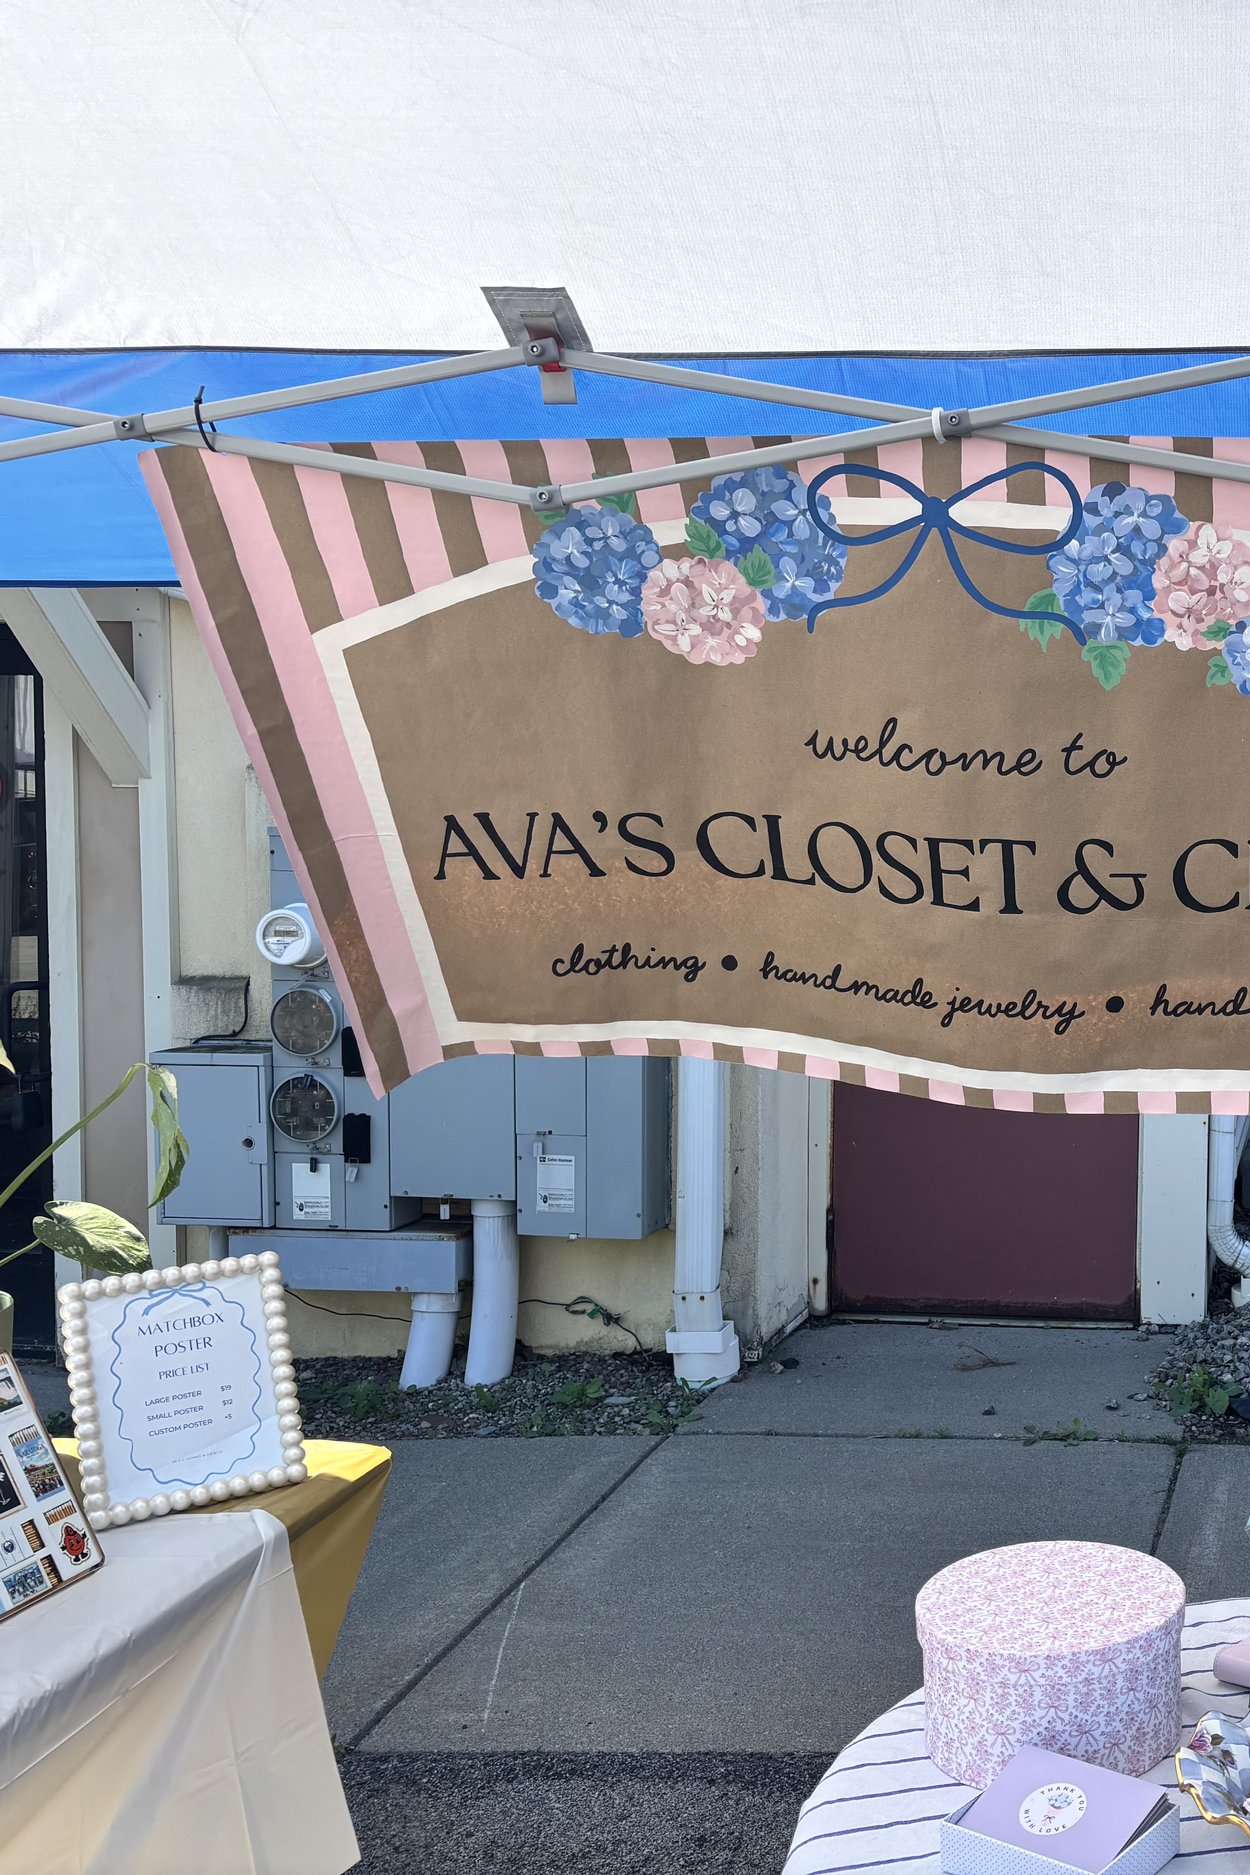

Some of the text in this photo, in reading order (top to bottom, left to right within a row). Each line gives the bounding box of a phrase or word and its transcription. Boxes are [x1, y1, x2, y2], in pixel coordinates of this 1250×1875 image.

[804, 717, 1128, 779] welcome to
[434, 810, 676, 880] AVA'S
[696, 811, 1036, 915] CLOSET
[1056, 838, 1147, 914] &
[551, 942, 707, 983] clothing
[760, 951, 1086, 1036] handmade jewelry
[137, 1312, 224, 1336] MATCHBOX
[154, 1336, 213, 1357] POSTER
[158, 1362, 211, 1380] PRICE LIST
[145, 1384, 232, 1407] LARGE POSTER $19
[146, 1399, 233, 1422] SMALL POSTER $12
[148, 1425, 182, 1437] CUSTOM
[183, 1418, 213, 1430] POSTER
[1040, 1786, 1085, 1812] THANK YOU
[1023, 1808, 1067, 1834] WITH LOVE
